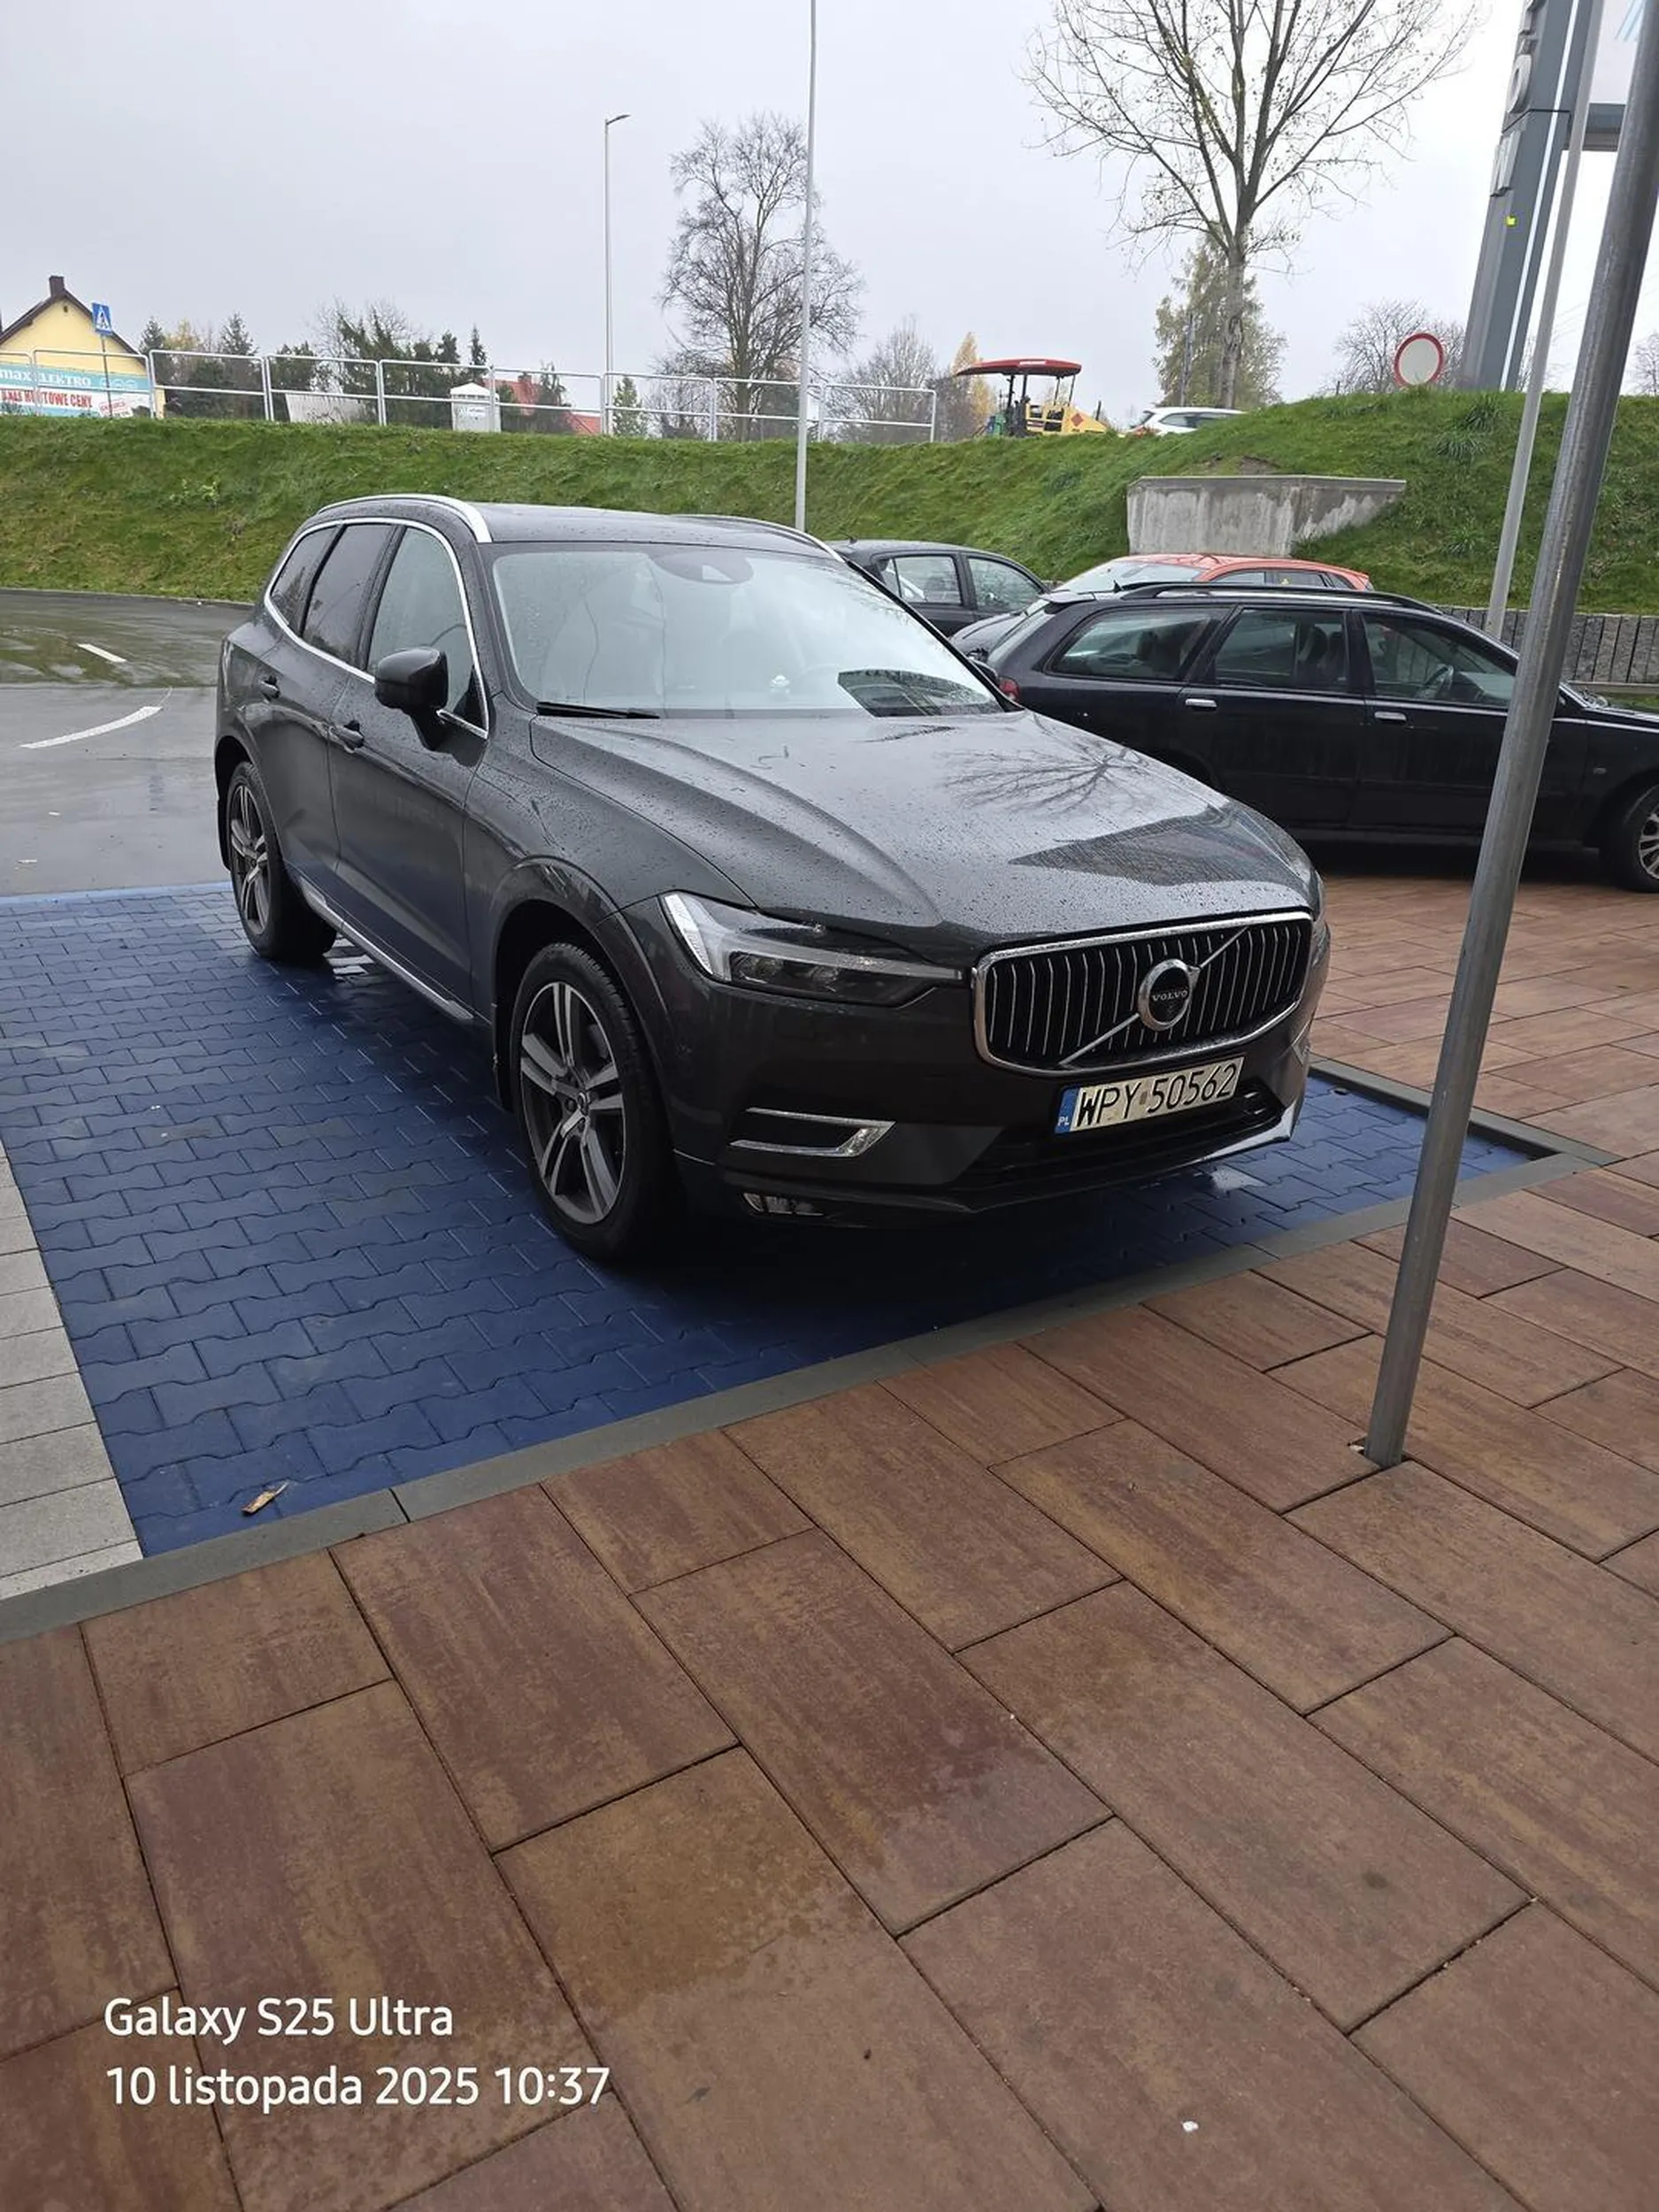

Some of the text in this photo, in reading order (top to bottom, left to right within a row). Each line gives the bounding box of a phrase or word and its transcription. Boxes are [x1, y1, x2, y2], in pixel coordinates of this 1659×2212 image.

[1152, 990, 1188, 1002] VOLVO
[1077, 1063, 1237, 1127] WPY 50562
[1057, 1116, 1070, 1126] PL
